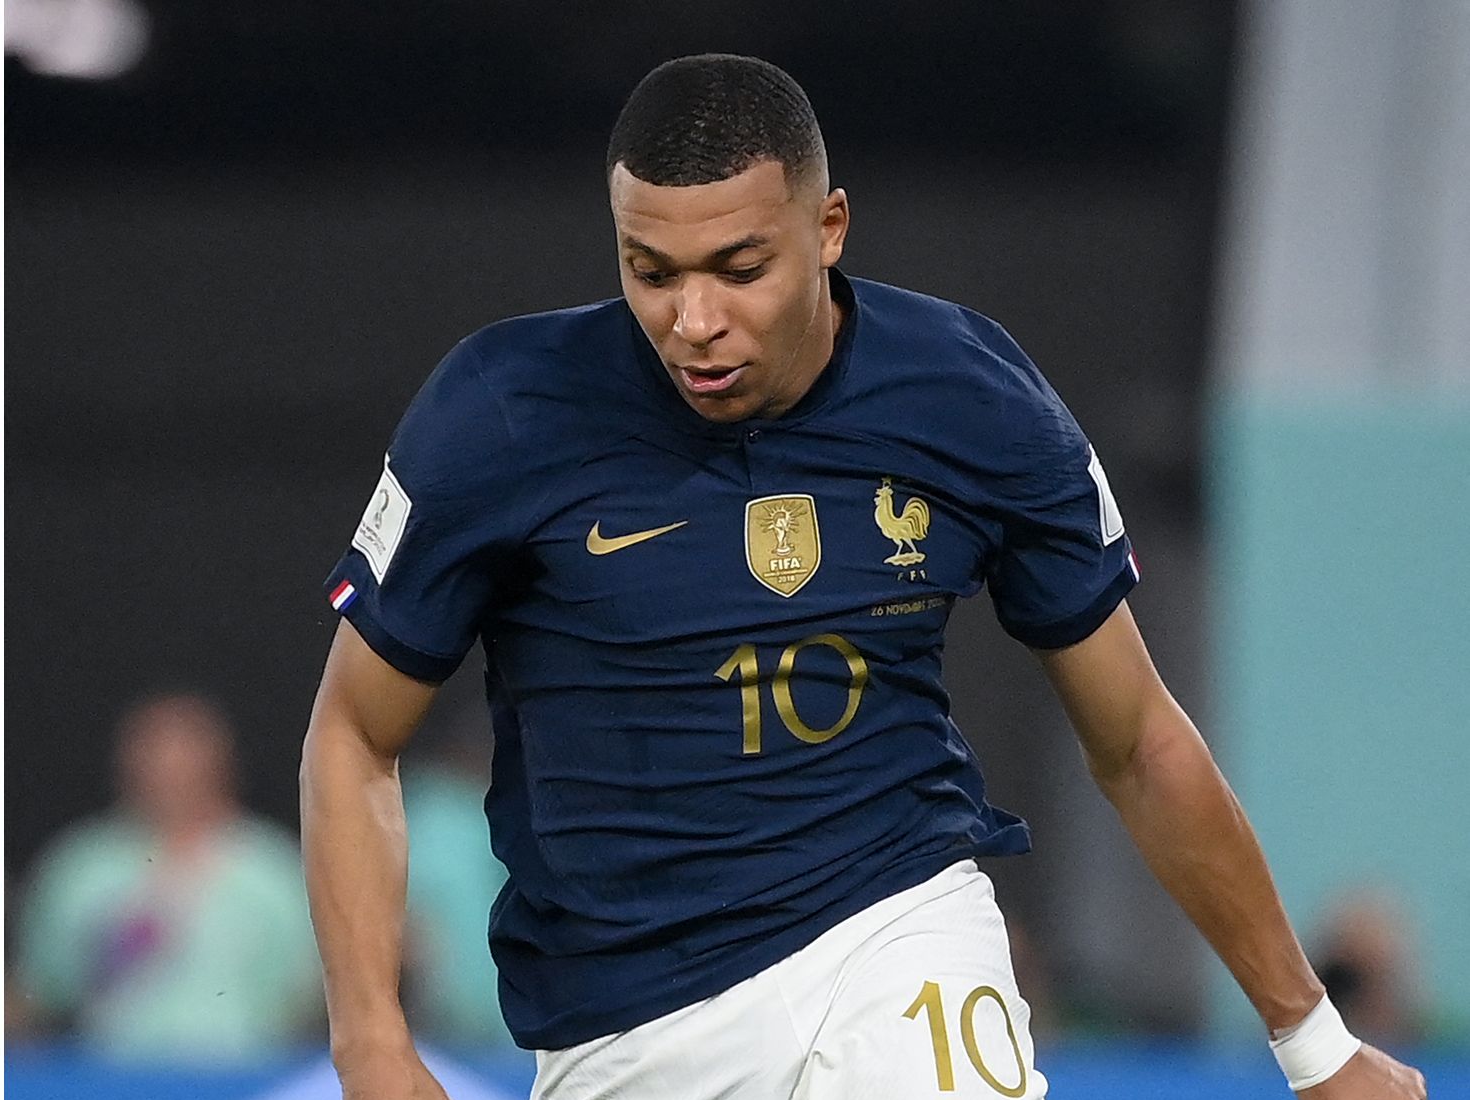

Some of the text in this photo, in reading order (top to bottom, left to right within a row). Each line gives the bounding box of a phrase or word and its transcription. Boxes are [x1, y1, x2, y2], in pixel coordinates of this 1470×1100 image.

[770, 557, 801, 571] FIFA
[713, 633, 869, 754] 10
[901, 980, 1027, 1098] 10
